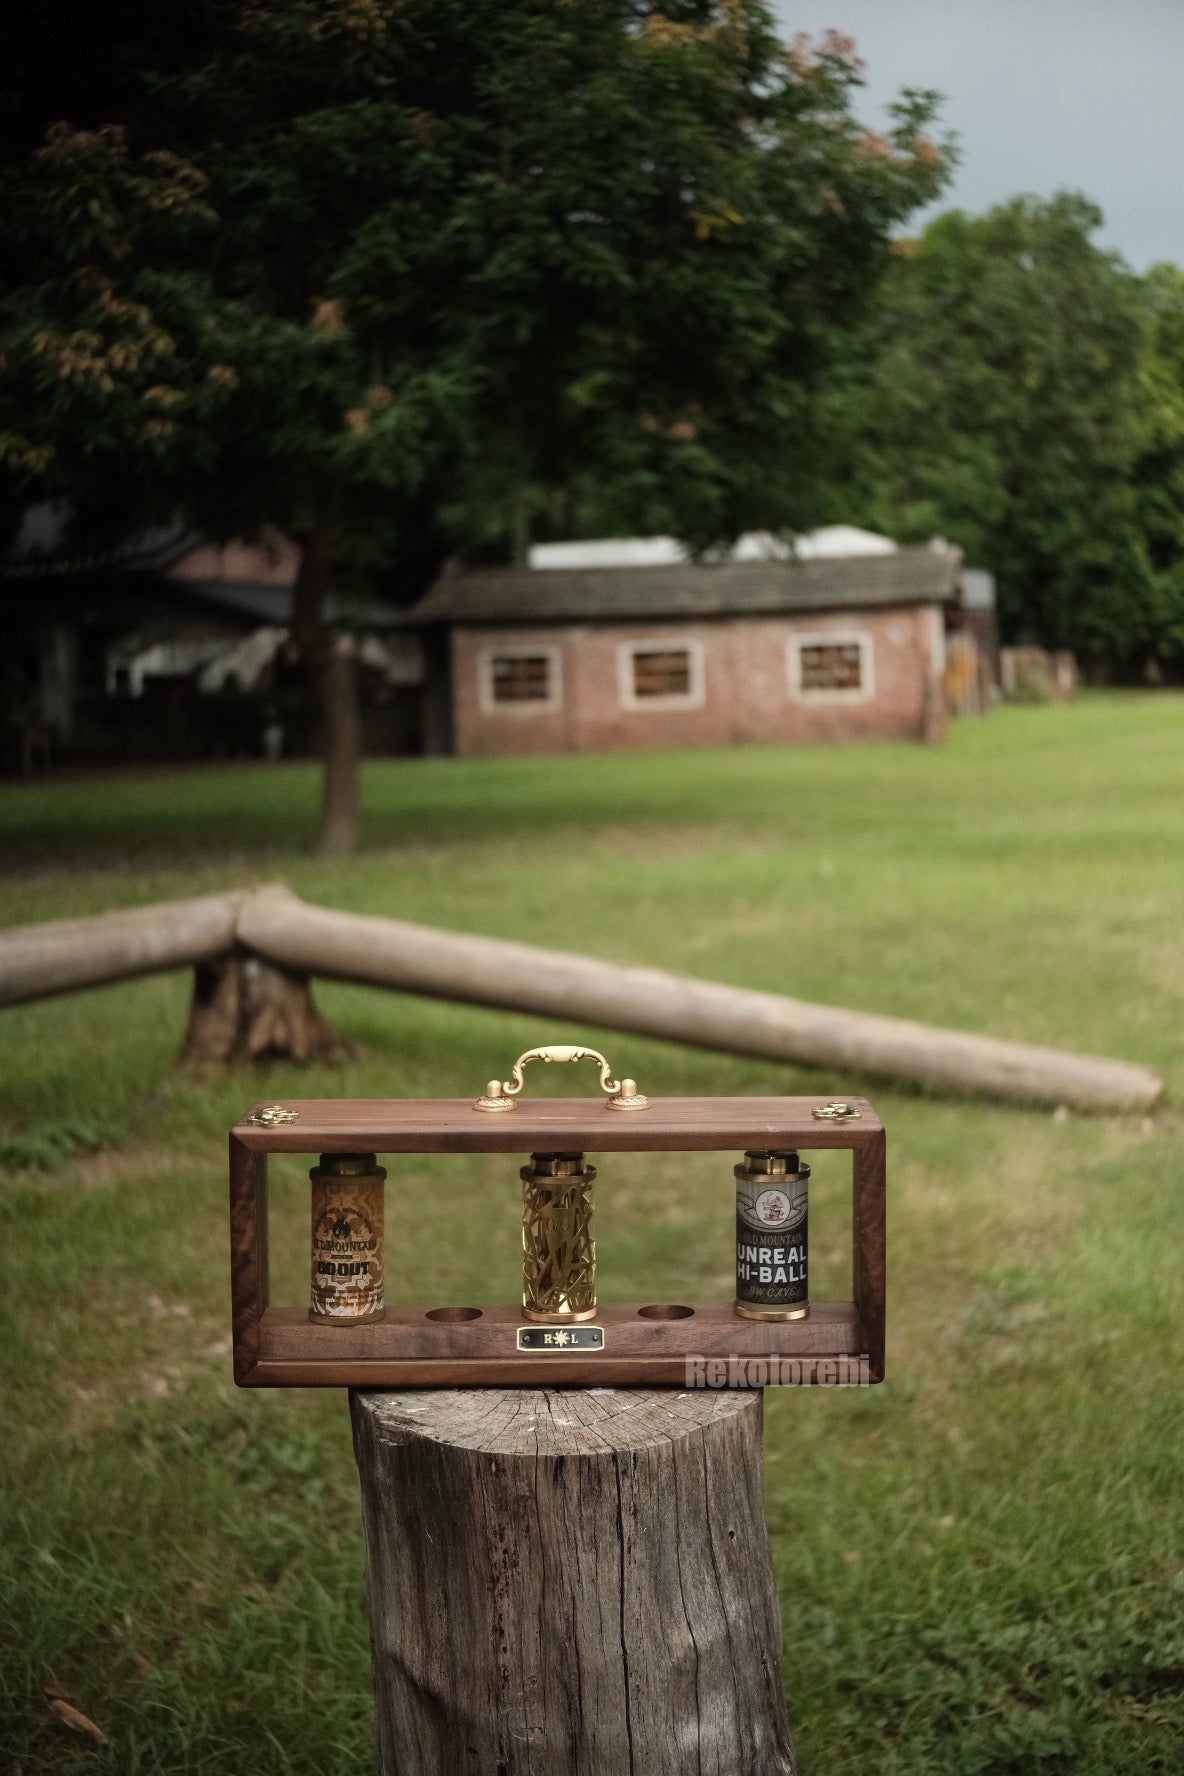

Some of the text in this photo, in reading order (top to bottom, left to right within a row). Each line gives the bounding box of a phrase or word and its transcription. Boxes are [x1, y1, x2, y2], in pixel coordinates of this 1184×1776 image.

[327, 1239, 377, 1252] MOUNTAIN
[738, 1244, 807, 1265] UNREAL
[338, 1261, 369, 1276] OUT
[738, 1262, 807, 1283] HI-BALL
